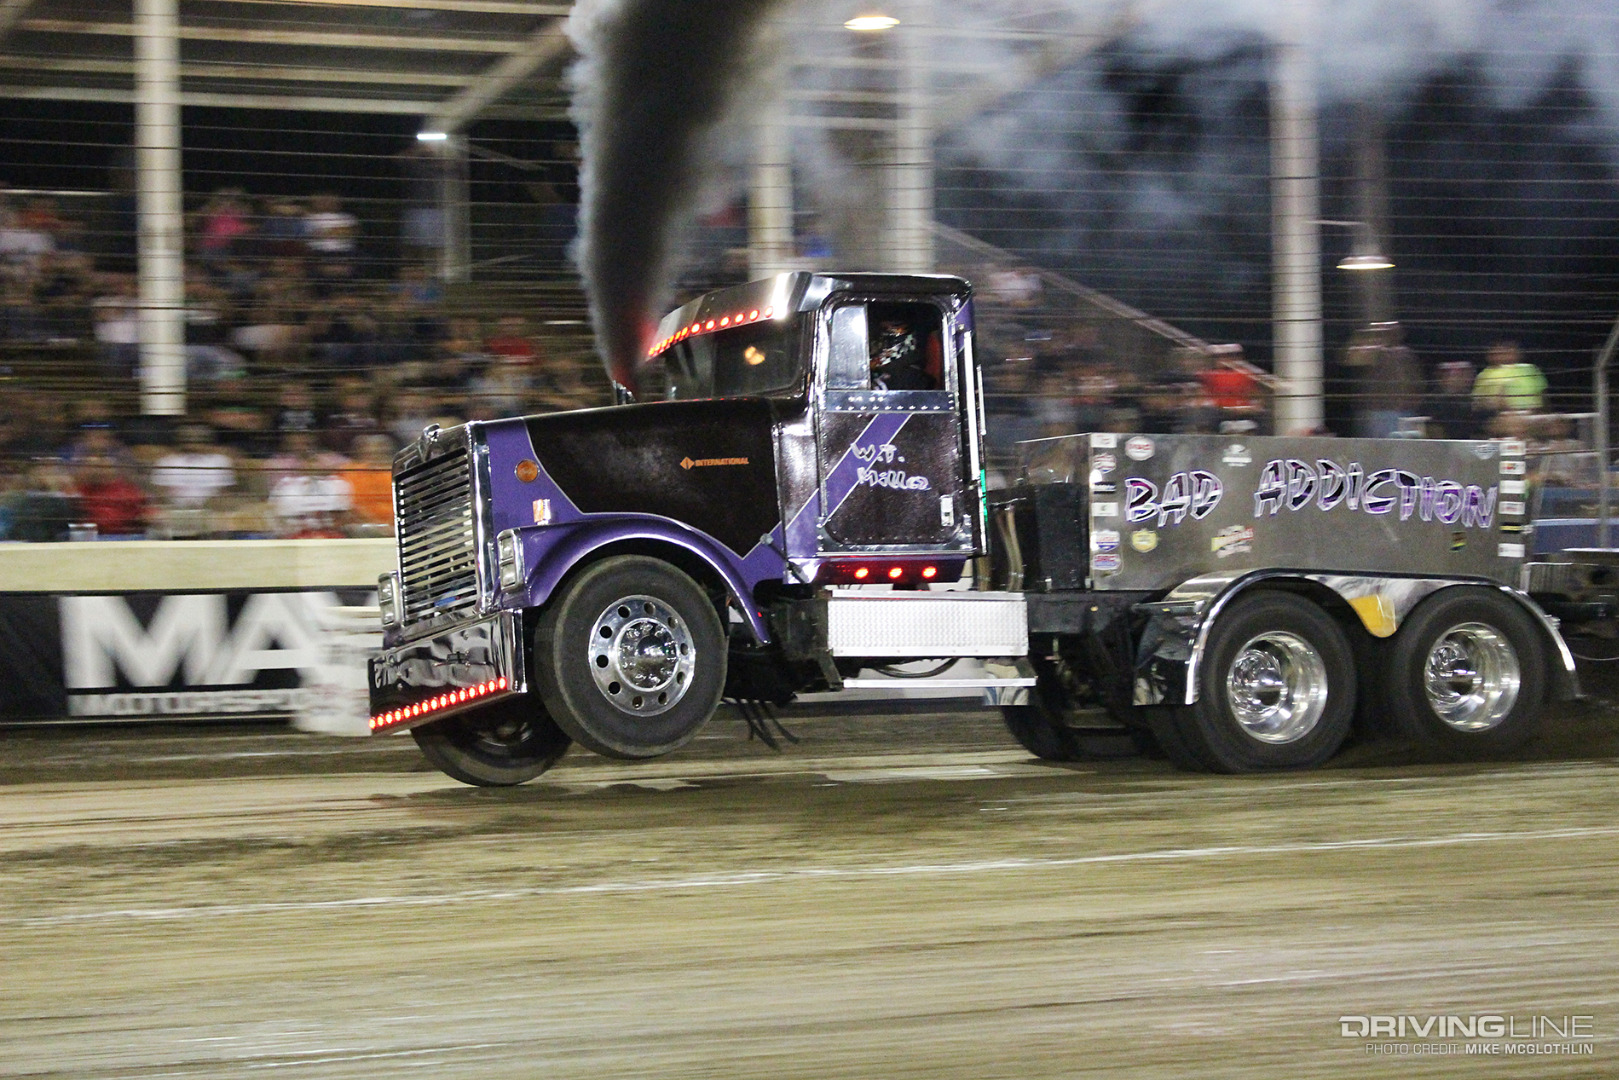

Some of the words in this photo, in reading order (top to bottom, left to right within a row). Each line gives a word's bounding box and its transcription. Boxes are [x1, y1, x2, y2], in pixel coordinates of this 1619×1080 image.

[695, 457, 749, 467] INTERNATIONAL
[1124, 471, 1223, 527] BAD
[1253, 457, 1498, 529] ADDICTION
